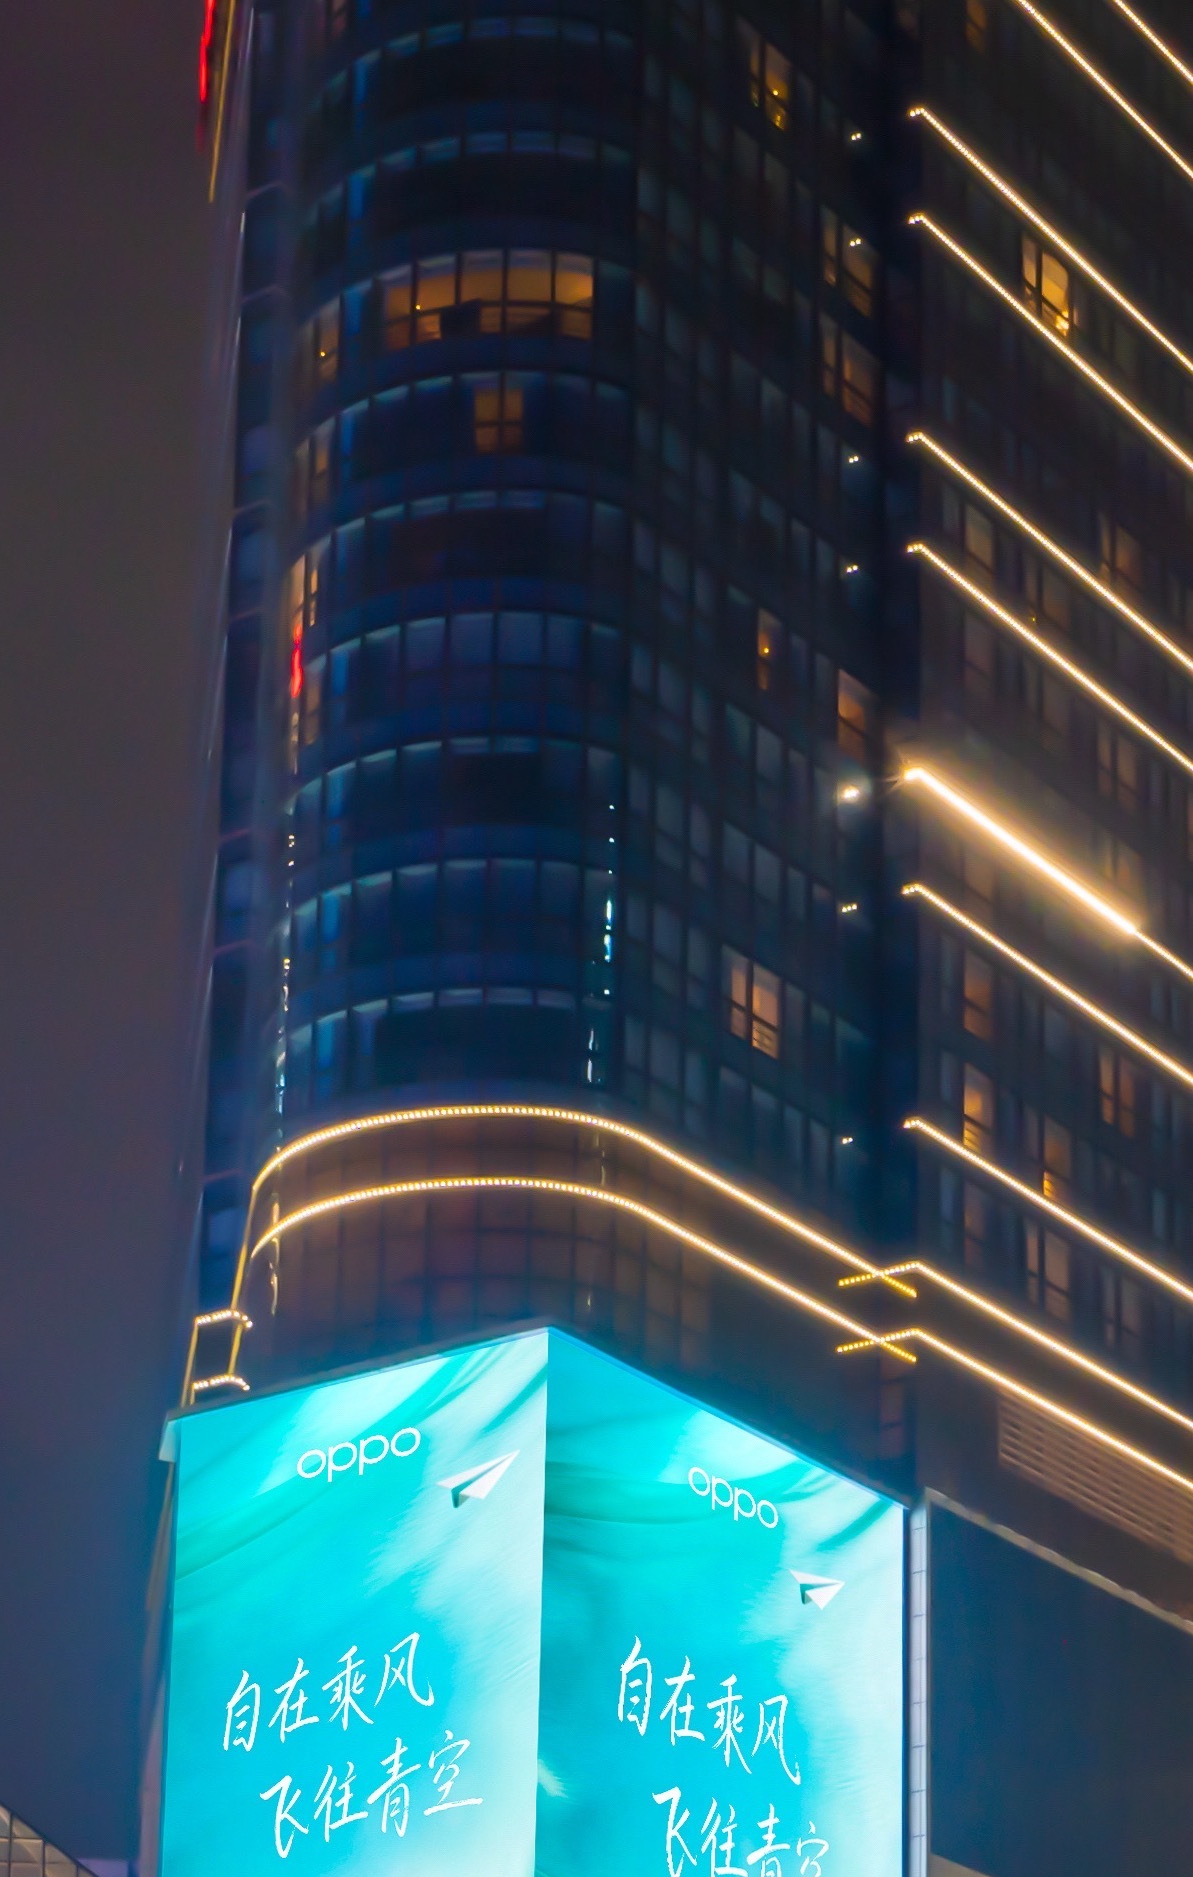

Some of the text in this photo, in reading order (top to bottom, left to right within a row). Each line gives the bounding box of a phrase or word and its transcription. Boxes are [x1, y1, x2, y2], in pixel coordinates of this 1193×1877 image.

[296, 1426, 421, 1481] oppo
[688, 1466, 779, 1530] oppo
[223, 1632, 435, 1752] 自在乘风
[617, 1635, 801, 1786] 自在乘风
[259, 1730, 483, 1859] 飞往青空
